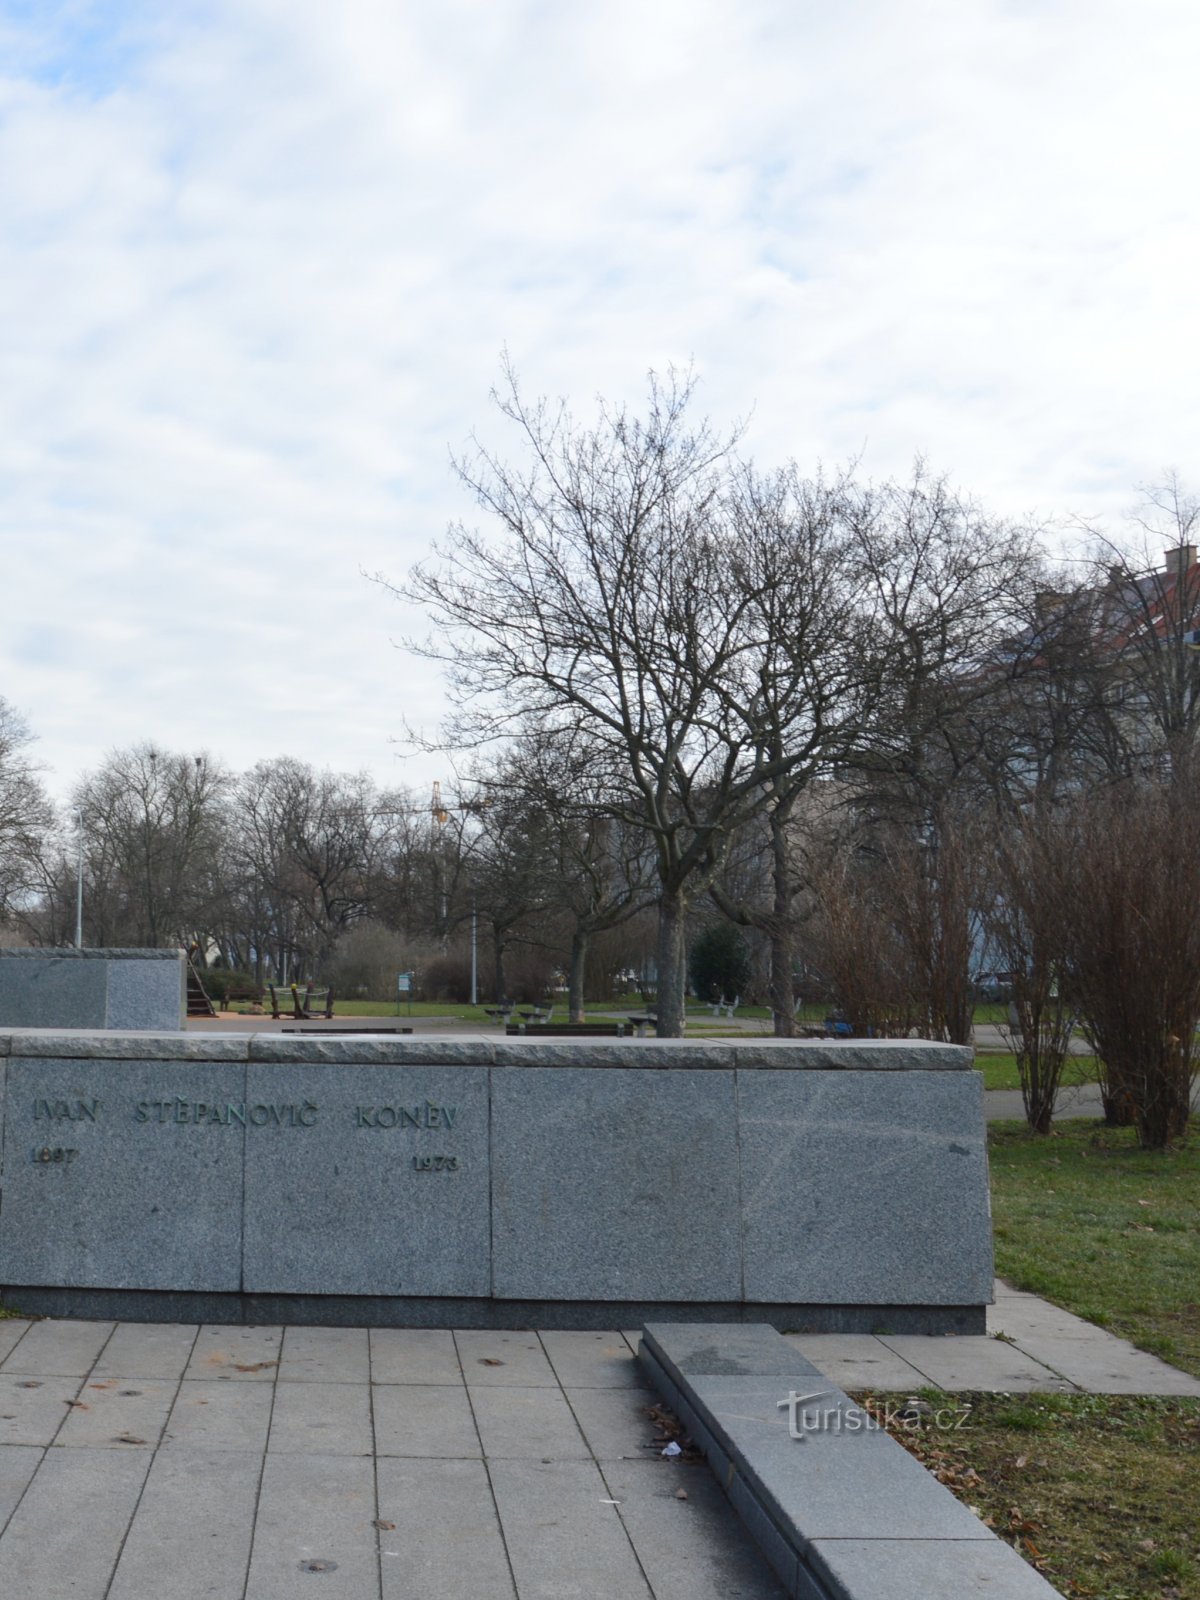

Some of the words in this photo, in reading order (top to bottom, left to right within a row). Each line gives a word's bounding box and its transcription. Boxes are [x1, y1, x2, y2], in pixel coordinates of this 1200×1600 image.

[34, 1099, 99, 1122] IVAN
[135, 1096, 318, 1127] STĚPANOVIČ
[356, 1100, 460, 1129] KONĚV
[413, 1156, 459, 1171] 1973
